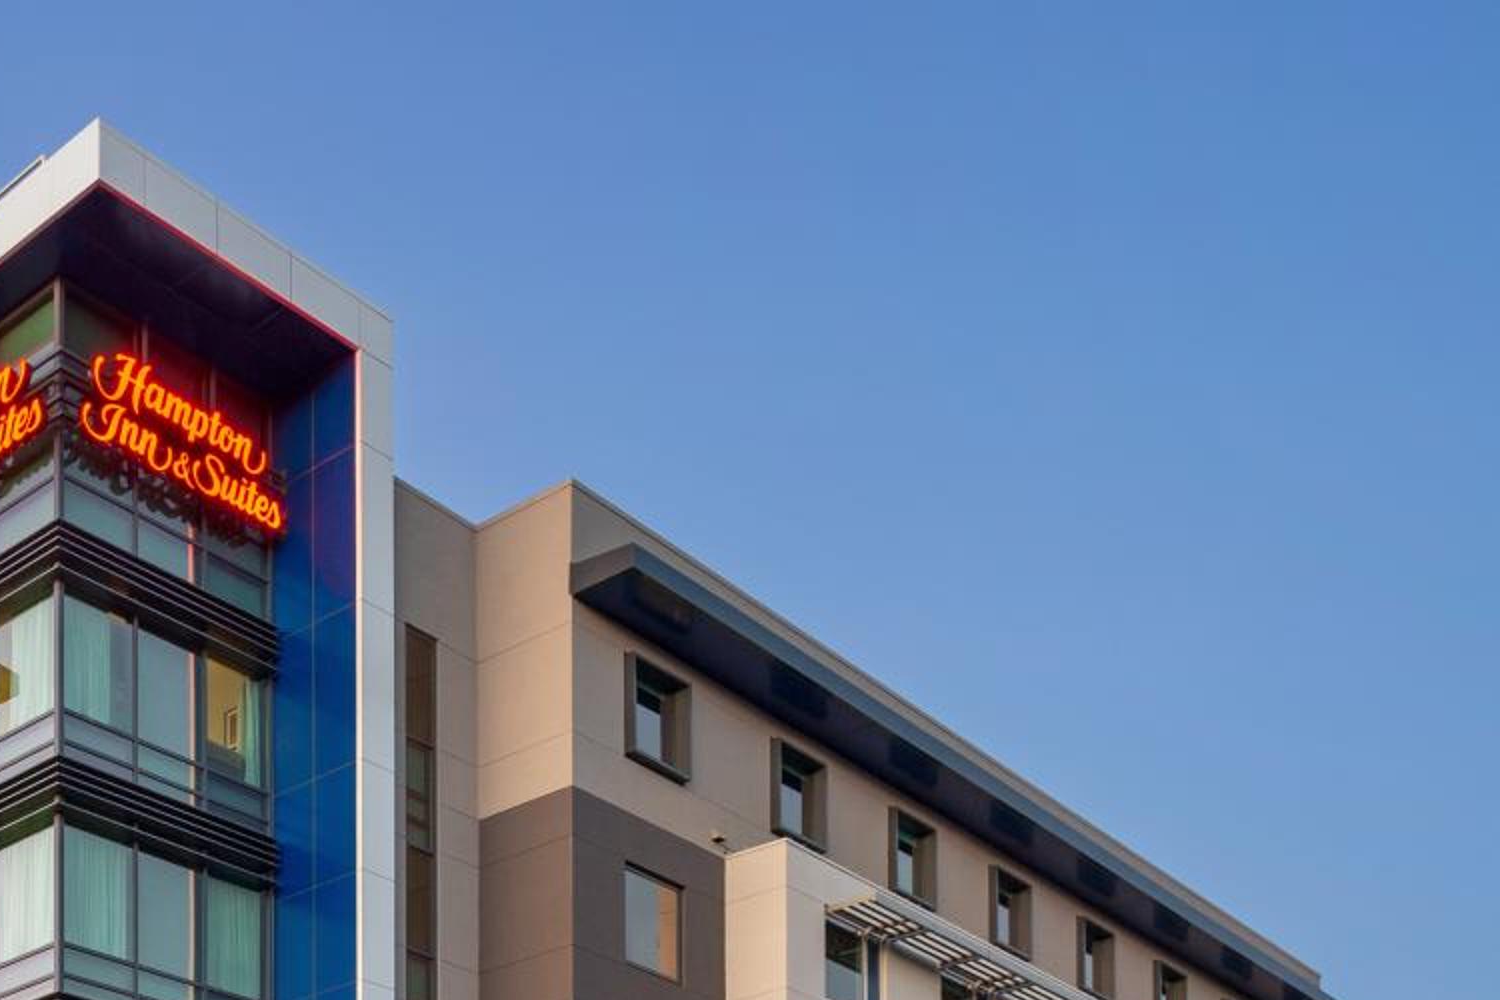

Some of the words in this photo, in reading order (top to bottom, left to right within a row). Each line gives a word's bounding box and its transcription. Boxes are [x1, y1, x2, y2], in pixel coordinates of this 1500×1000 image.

[82, 402, 173, 472] Inn
[173, 452, 195, 490] &
[193, 454, 282, 530] Suites
[93, 353, 266, 475] Hampton
